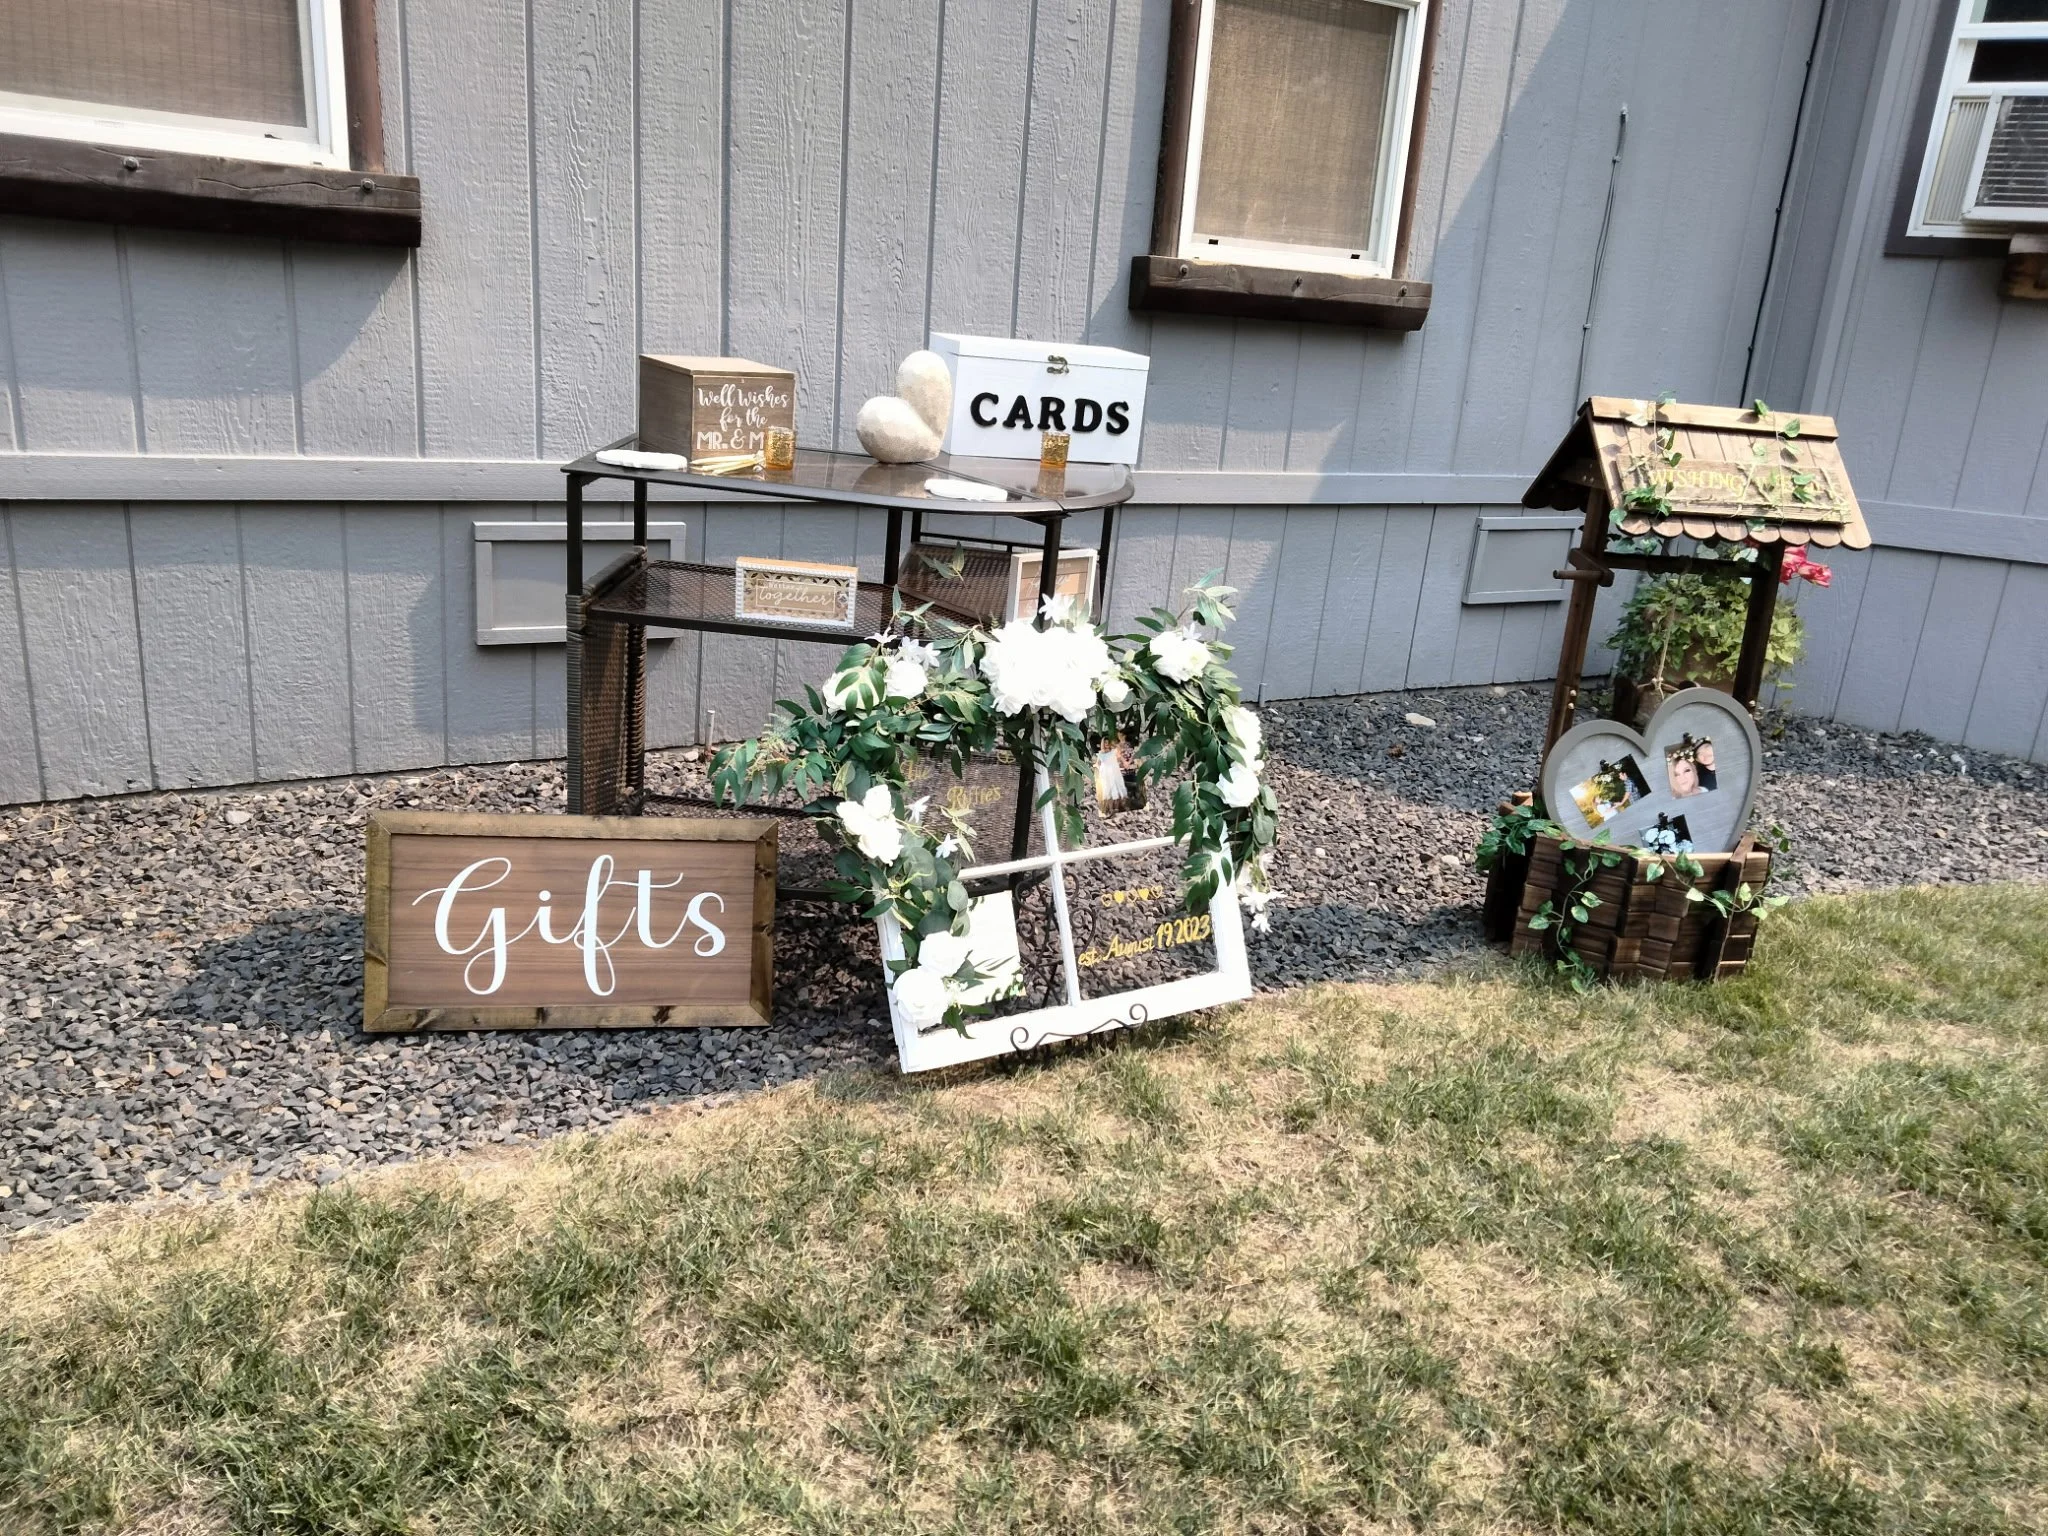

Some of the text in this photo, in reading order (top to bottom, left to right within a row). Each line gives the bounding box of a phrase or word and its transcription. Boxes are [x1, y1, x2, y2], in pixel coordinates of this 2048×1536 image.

[698, 384, 790, 408] Well Wishes
[720, 407, 767, 432] for the
[970, 391, 1130, 435] CARDS
[697, 431, 728, 450] MR.
[730, 428, 746, 449] &
[1650, 469, 1745, 499] WISHING
[759, 585, 833, 606] together
[411, 854, 727, 996] Gifts
[1103, 934, 1156, 961] August
